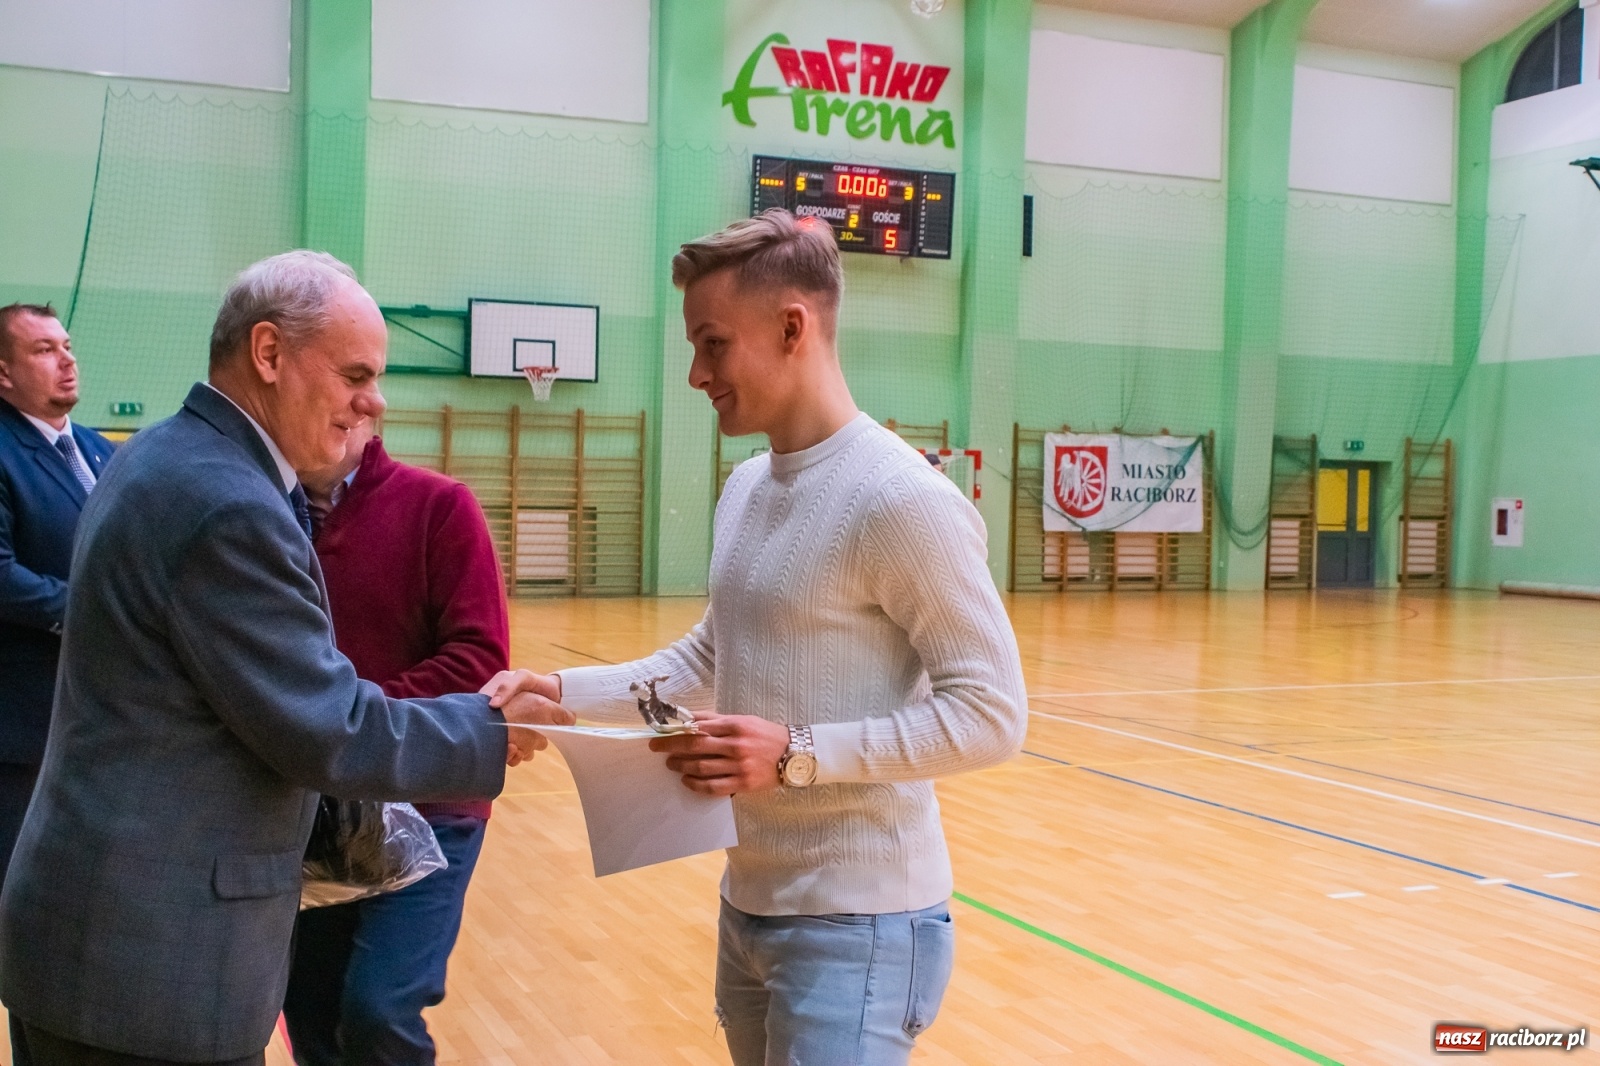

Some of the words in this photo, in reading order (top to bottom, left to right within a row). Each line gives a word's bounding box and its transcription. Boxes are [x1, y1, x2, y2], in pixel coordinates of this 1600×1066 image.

[771, 39, 951, 103] RAFAKO
[722, 32, 955, 148] Arena
[904, 186, 914, 201] 3
[796, 204, 846, 220] GOSPODARZE
[872, 209, 901, 224] GOŚCIE
[848, 214, 859, 229] 2
[884, 229, 896, 248] 5
[1121, 463, 1186, 480] MIASTO
[1110, 486, 1197, 503] RACIBORZ
